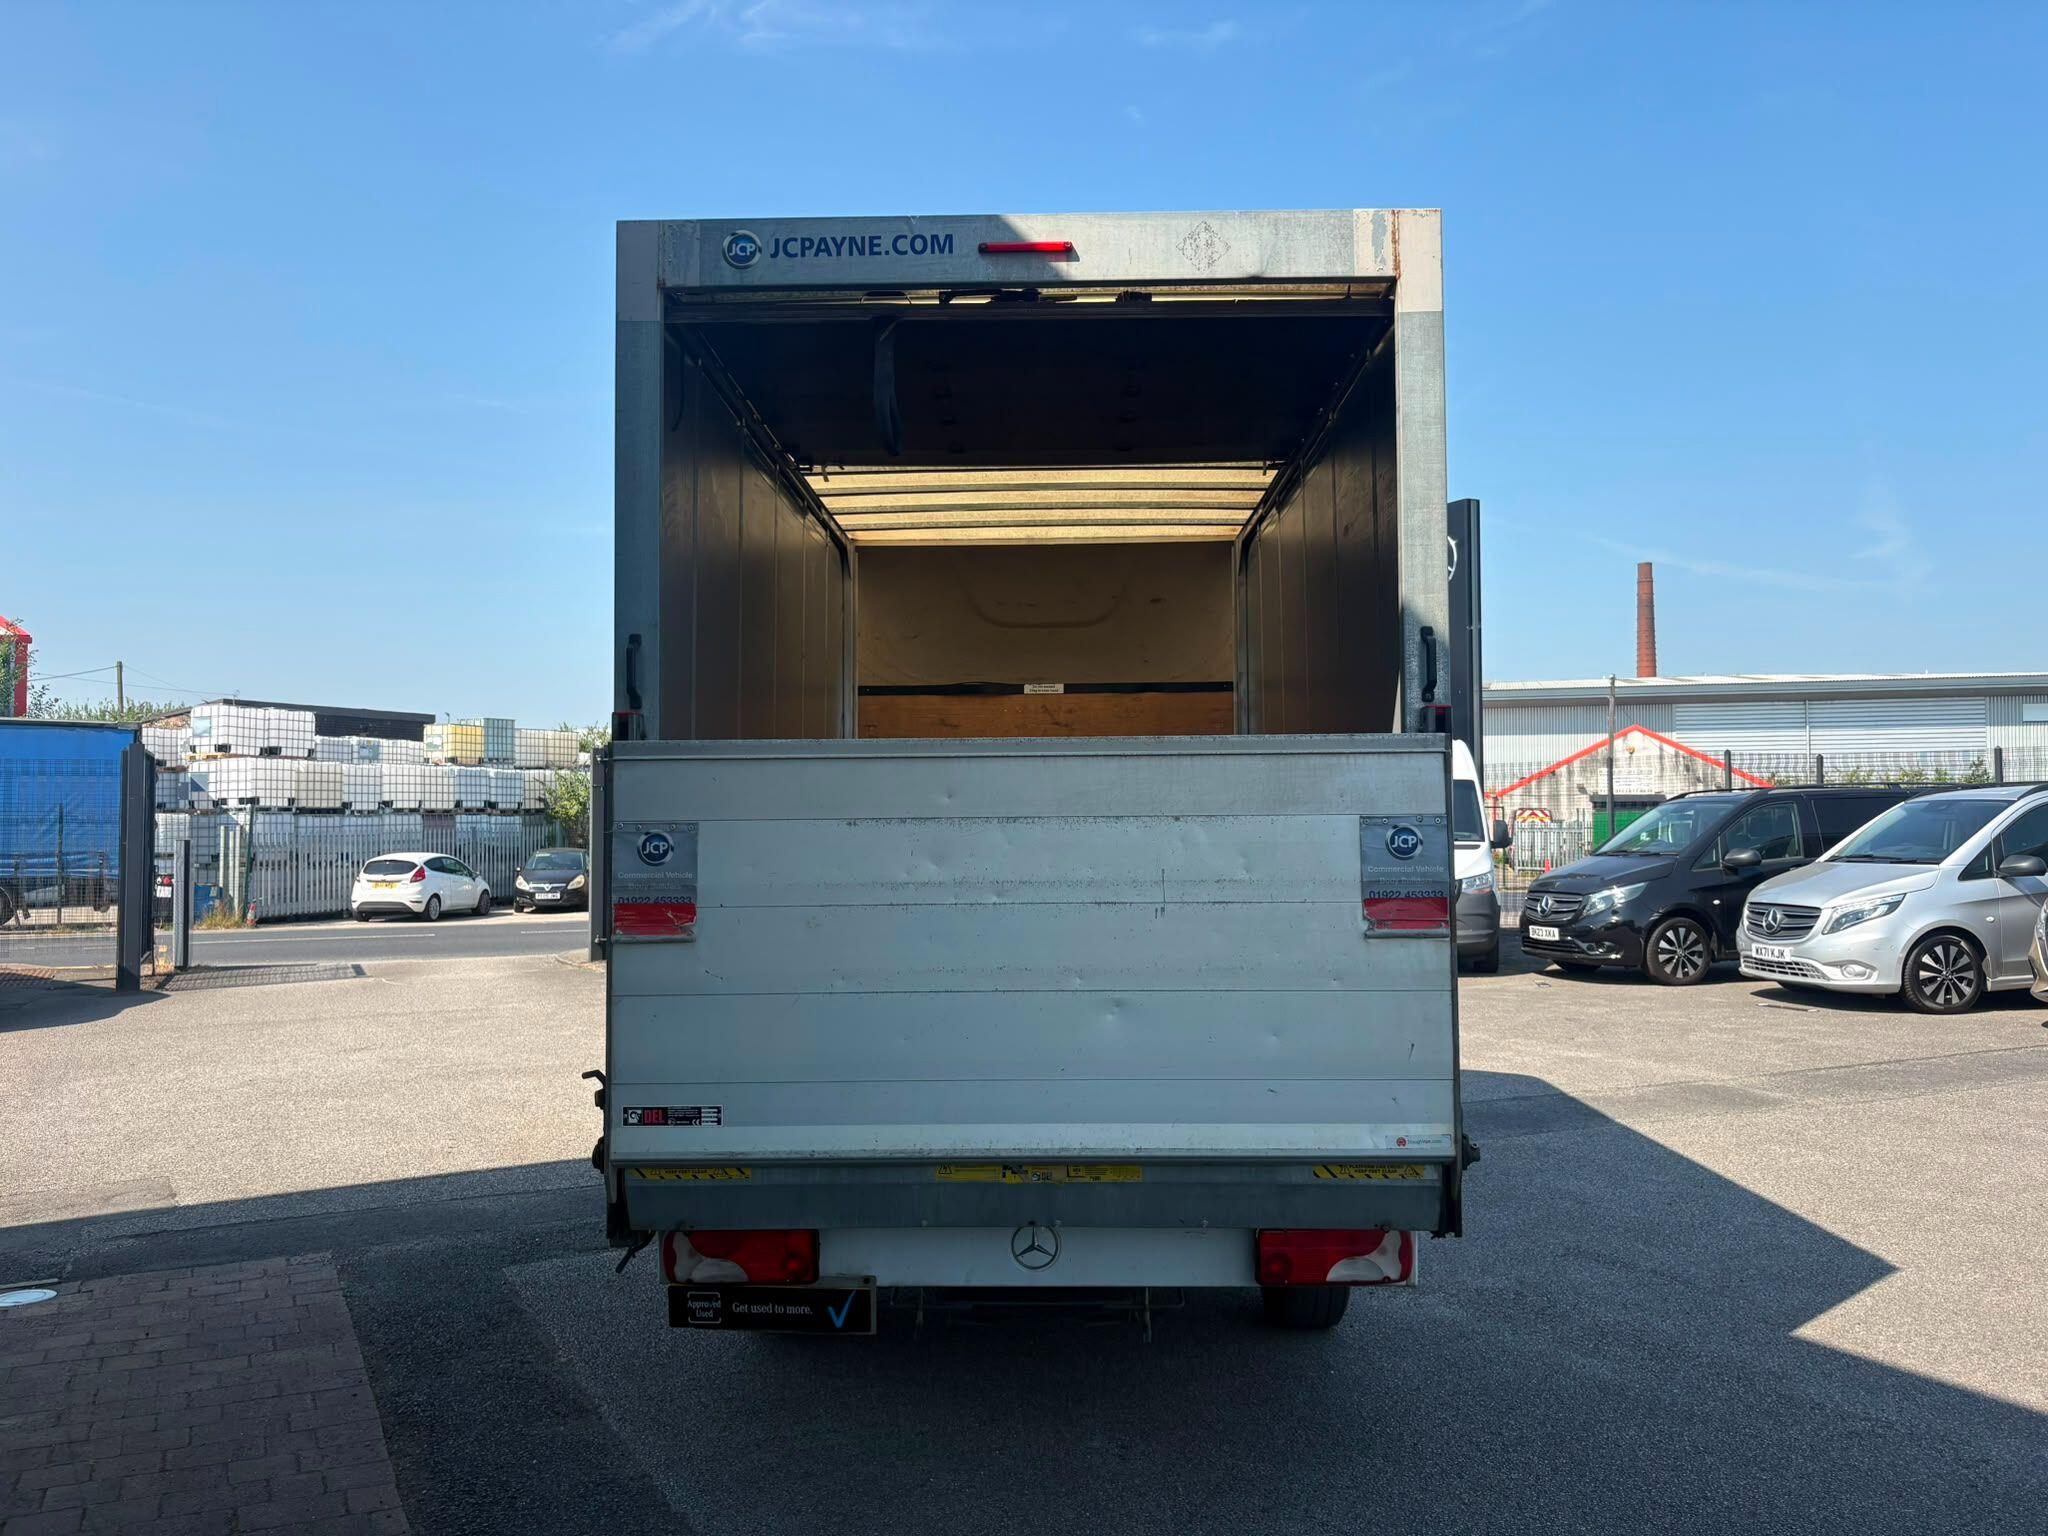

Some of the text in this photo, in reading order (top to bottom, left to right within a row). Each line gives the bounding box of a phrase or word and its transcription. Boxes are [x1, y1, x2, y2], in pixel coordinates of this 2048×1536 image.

[728, 241, 756, 257] JCP
[770, 233, 954, 259] JCPAYNE.COM
[643, 841, 668, 854] JCP
[1391, 835, 1417, 848] JCP
[1367, 865, 1444, 873] Commercial Vehicle
[696, 1310, 714, 1318] Used
[732, 1302, 813, 1316] Get used to more.
